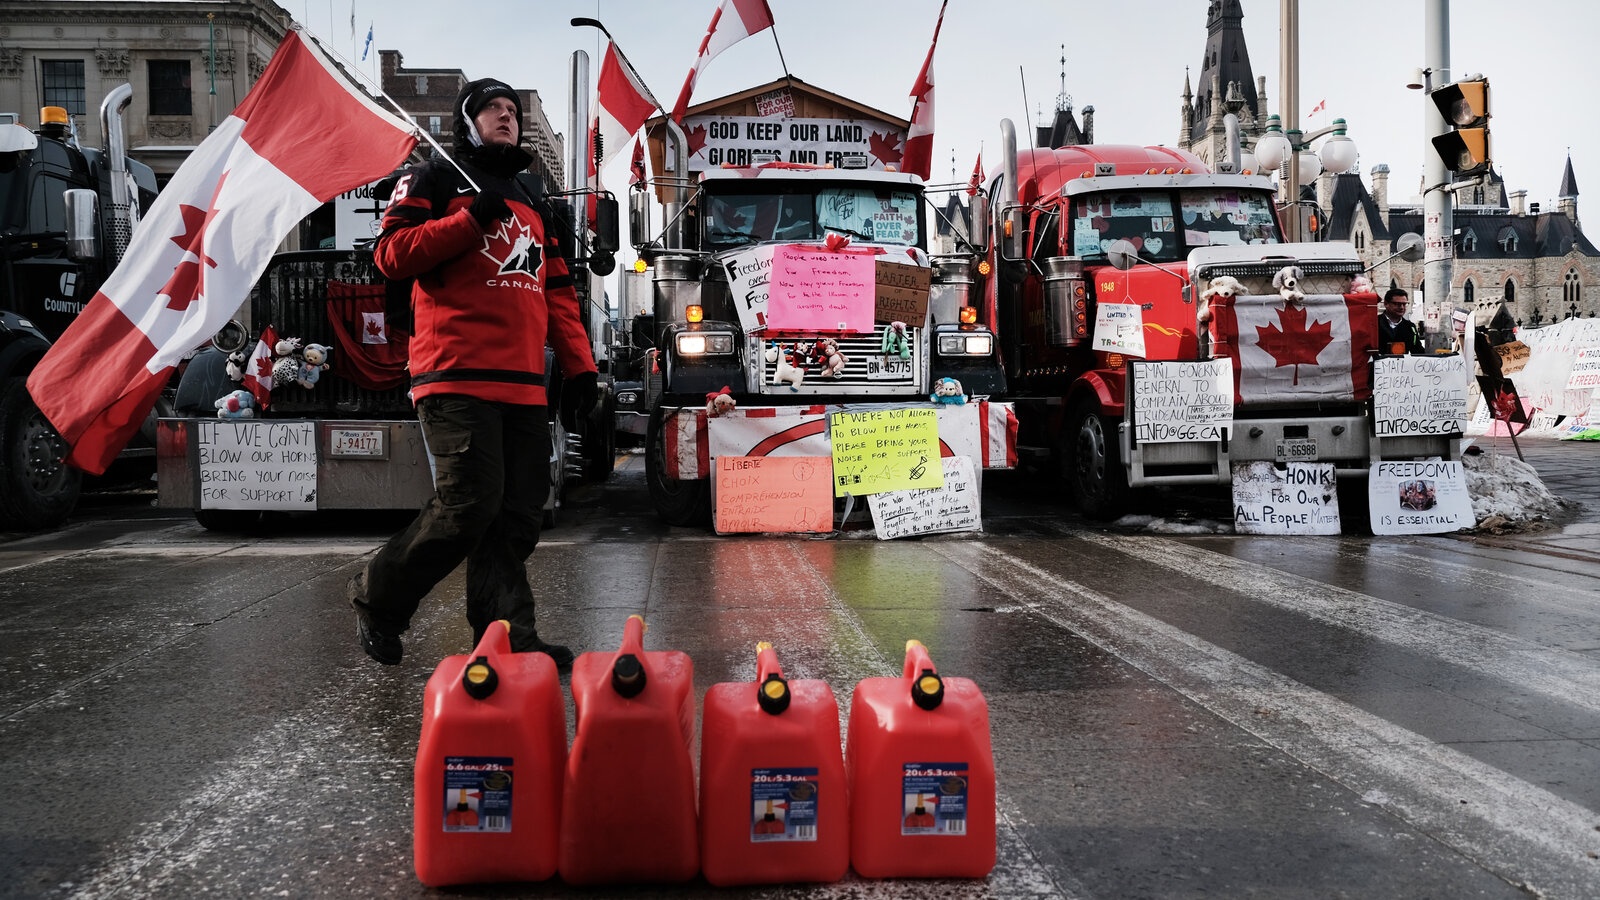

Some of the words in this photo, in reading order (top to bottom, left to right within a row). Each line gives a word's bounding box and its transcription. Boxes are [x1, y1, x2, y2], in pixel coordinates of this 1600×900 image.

[762, 90, 781, 101] PRAY
[758, 100, 773, 110] FOR
[775, 96, 791, 105] OUR
[760, 103, 793, 117] LEADERS
[709, 121, 738, 139] GOD
[747, 123, 782, 141] KEEP
[789, 125, 819, 142] OUR
[826, 125, 867, 144] LAND,
[708, 148, 782, 166] GLORIS
[789, 150, 818, 165] AND
[873, 213, 903, 221] FAITH
[876, 222, 902, 230] OVER
[749, 272, 769, 286] over
[876, 270, 917, 286] HARTER
[1101, 281, 1115, 293] 1948
[745, 291, 769, 310] Fea
[880, 295, 917, 310] RIGHTS
[869, 361, 880, 374] BN
[884, 361, 911, 373] 45775
[1136, 380, 1187, 394] GENERAL
[1193, 379, 1209, 392] TO
[1376, 376, 1420, 390] GENERAL
[1424, 375, 1441, 386] TO
[1195, 393, 1227, 405] ABOUT
[1426, 388, 1461, 402] ABOUT
[831, 412, 847, 427] IF
[889, 410, 905, 419] NOT
[1135, 409, 1185, 423] TRUDEAU
[1375, 405, 1428, 418] TRUDEAU
[851, 427, 877, 437] BLOW
[885, 424, 901, 433] THE
[1135, 423, 1221, 441] INFO@GG.CA
[1376, 418, 1460, 434] INFO@GG.CA
[199, 423, 220, 445] IF
[235, 423, 262, 447] WE
[336, 438, 377, 449] J-94177
[876, 440, 904, 449] BRING
[908, 438, 928, 447] YOUR
[1277, 445, 1287, 457] BL
[1291, 444, 1317, 456] 66988
[200, 448, 242, 465] BLOW
[251, 451, 273, 462] OUR
[837, 455, 863, 464] NOISE
[201, 470, 246, 482] BRING
[1286, 466, 1337, 486] HONK!
[1378, 463, 1456, 479] FREEDOM!
[203, 487, 231, 501] FOR
[917, 498, 934, 508] that
[1381, 515, 1392, 526] IS
[1398, 513, 1458, 525] ESSENTIAL!
